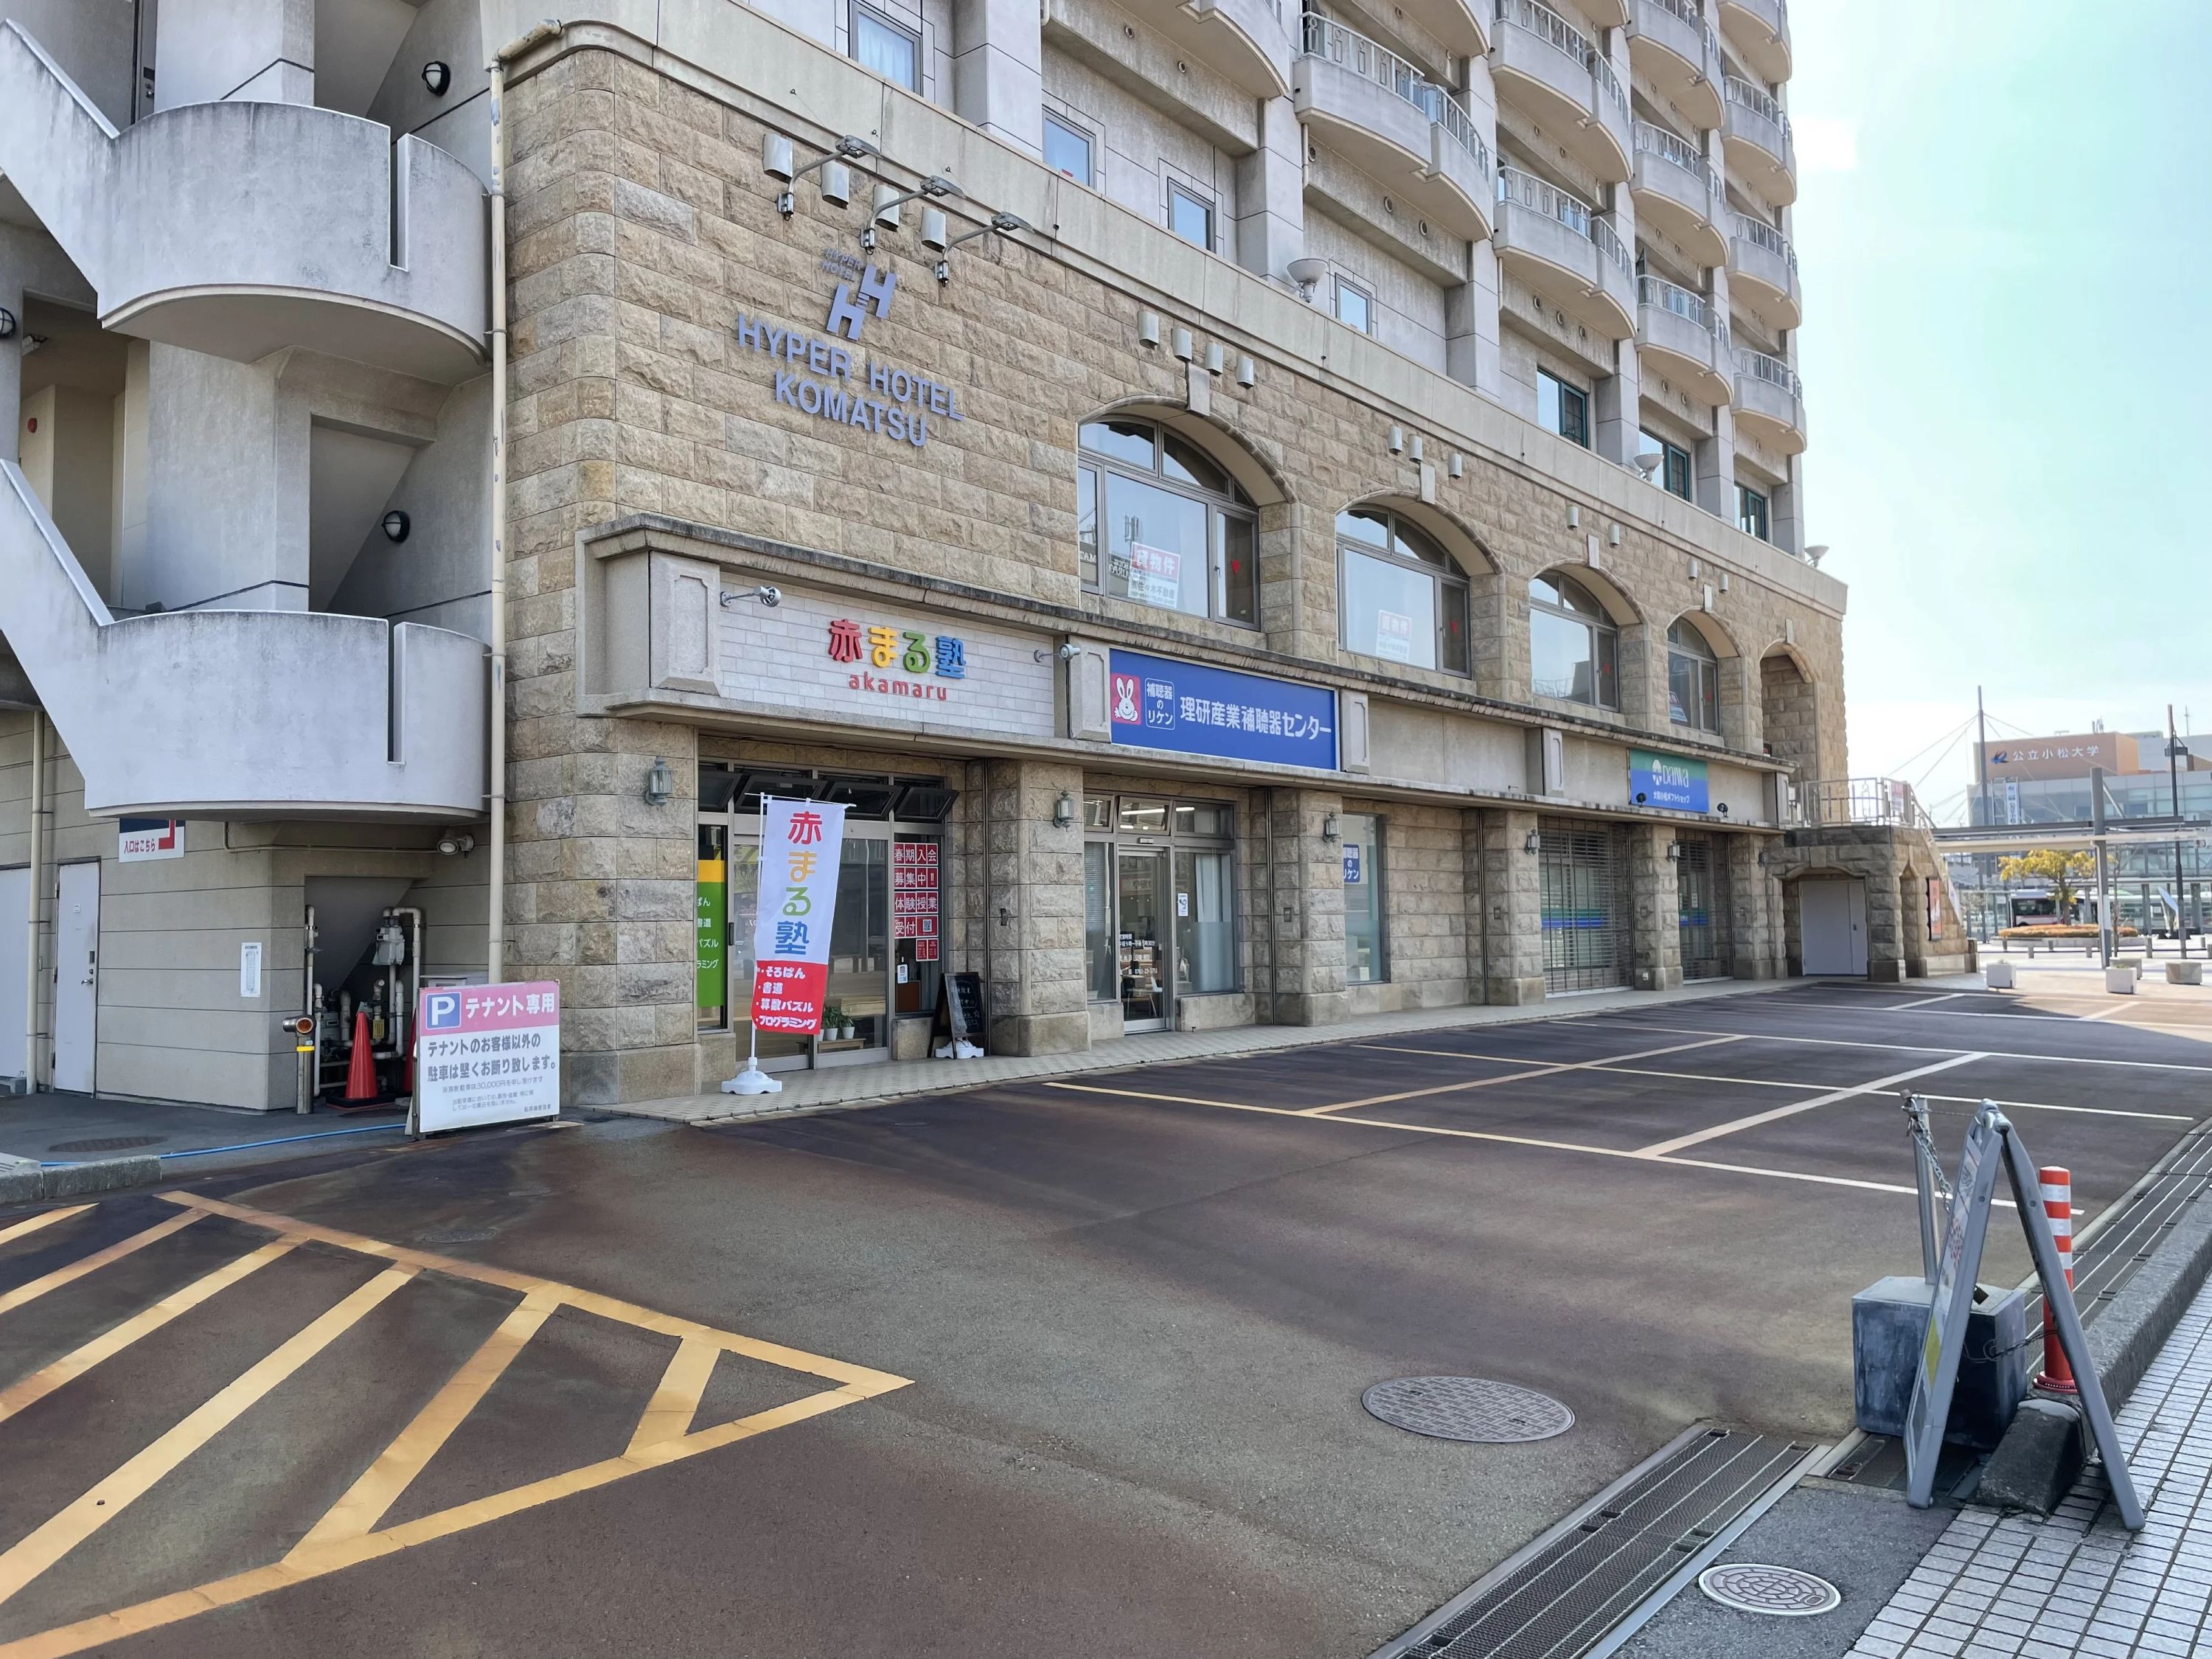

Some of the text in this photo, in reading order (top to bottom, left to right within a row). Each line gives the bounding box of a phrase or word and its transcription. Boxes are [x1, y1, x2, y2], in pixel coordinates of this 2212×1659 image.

[738, 313, 964, 421] HYPER HOTEL
[775, 370, 927, 447] KOMATSU
[829, 619, 967, 679] 赤まる塾
[849, 672, 947, 700] akamaru
[1147, 682, 1172, 700] 補聴器
[1157, 700, 1164, 709] の
[1148, 709, 1173, 725] リケン
[1180, 696, 1332, 740] 理研産業補聴器センター
[2013, 745, 2099, 762] 公立小松大学
[124, 838, 156, 854] 入口はこちら
[894, 848, 937, 862] 春期入会
[1347, 859, 1352, 868] の
[775, 810, 822, 956] 赤まる塾
[894, 897, 937, 911] 体験授業
[895, 921, 916, 937] 受付
[431, 992, 555, 1026] P テナント専用
[428, 1033, 540, 1057] テナントのお客様以外の
